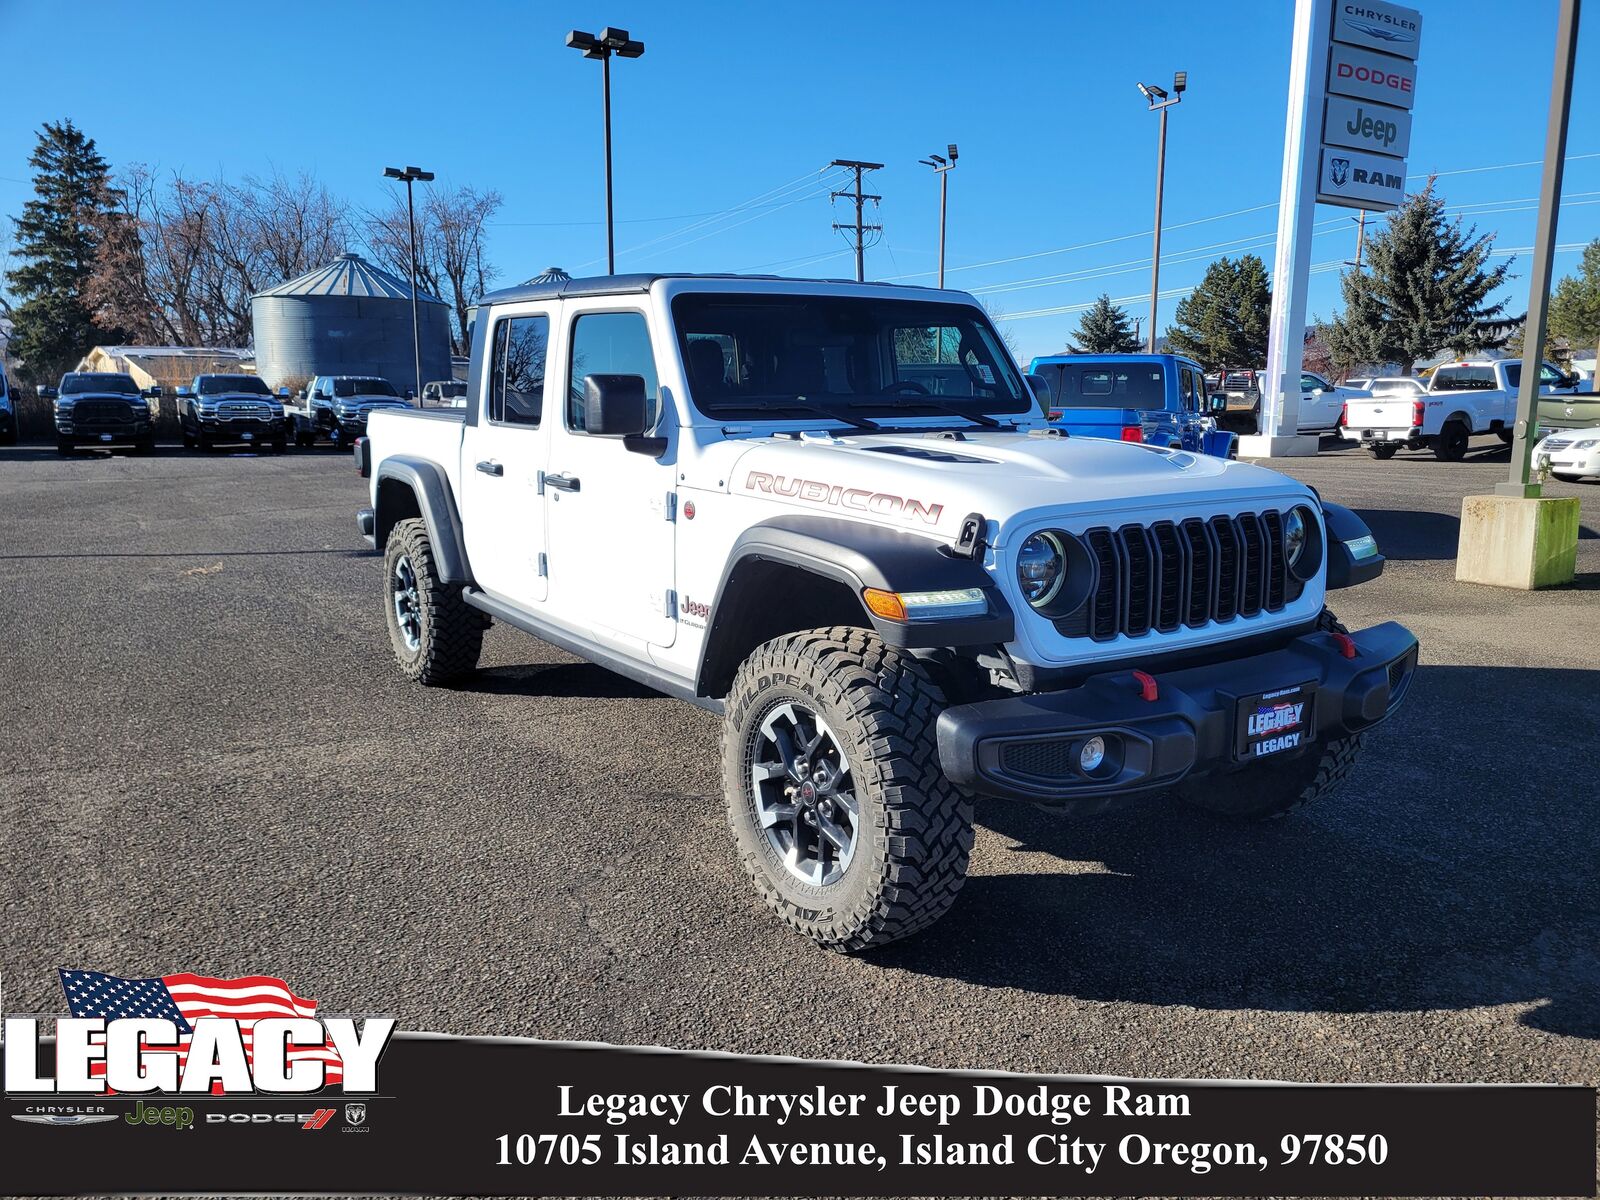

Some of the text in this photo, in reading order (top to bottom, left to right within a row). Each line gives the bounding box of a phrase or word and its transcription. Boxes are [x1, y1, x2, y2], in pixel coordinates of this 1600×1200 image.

[1344, 5, 1416, 32] CHRYSLER
[1337, 63, 1412, 93] DODGE
[1346, 108, 1397, 147] Jeep
[1353, 168, 1402, 190] RAM
[745, 470, 944, 525] RUBICON
[732, 672, 833, 733] WILDPEAK
[1248, 702, 1304, 736] LEGACY
[1256, 733, 1300, 756] LEGACY
